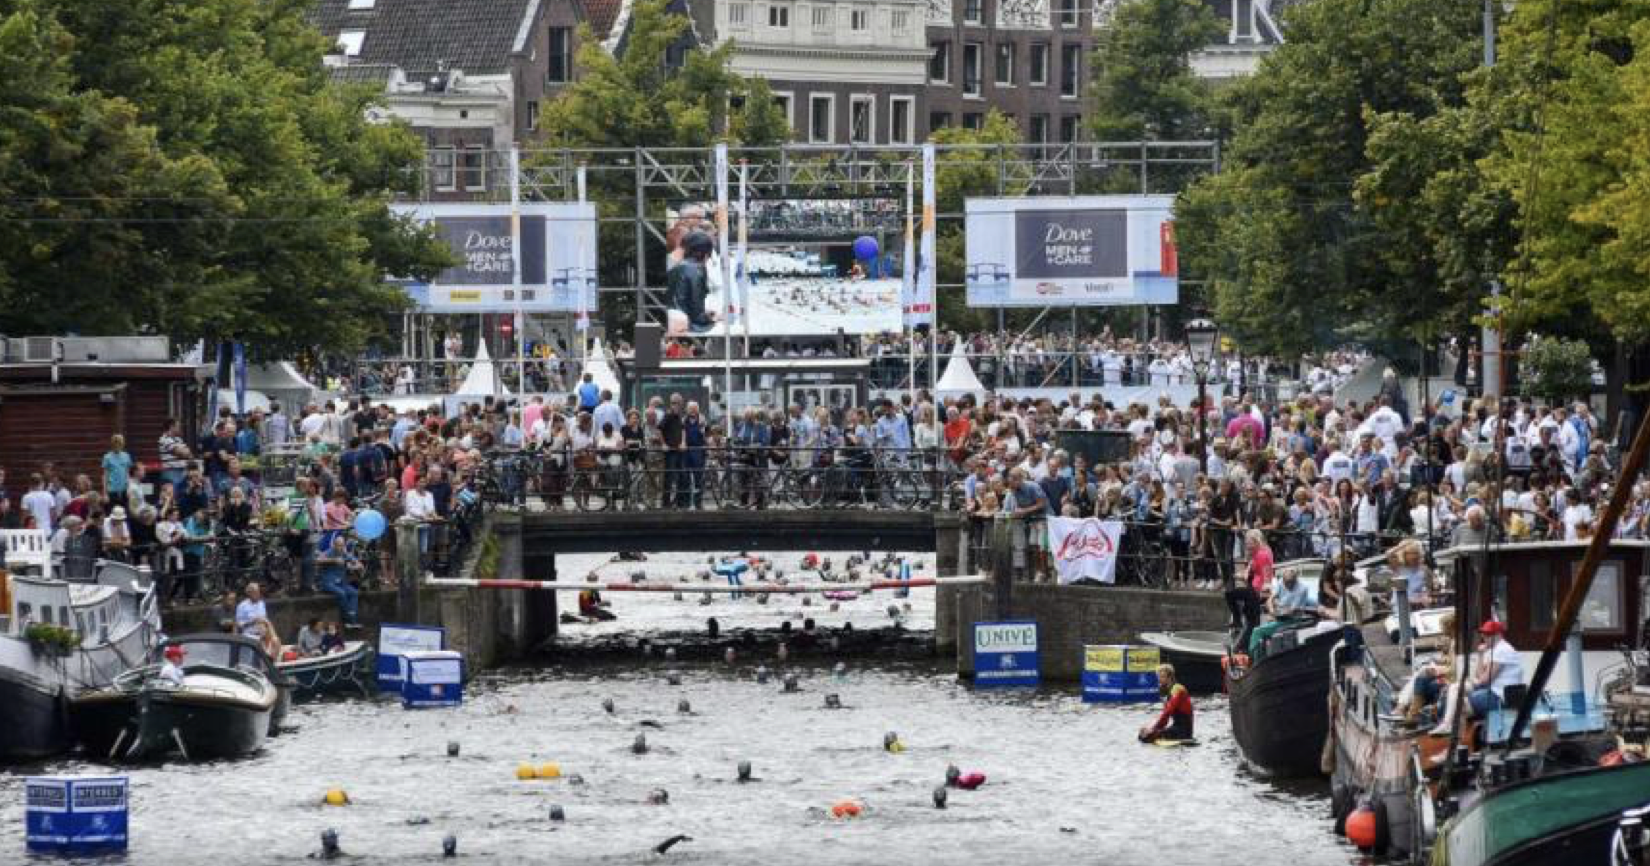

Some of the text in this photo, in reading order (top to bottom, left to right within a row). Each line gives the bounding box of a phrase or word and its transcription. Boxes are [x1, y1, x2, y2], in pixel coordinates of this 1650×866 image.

[465, 230, 512, 249] Dove
[1045, 222, 1092, 243] Dove
[466, 252, 495, 262] MEN
[1045, 245, 1077, 255] MEN
[1047, 255, 1092, 265] +CARE
[977, 627, 1036, 648] UNIVÉ
